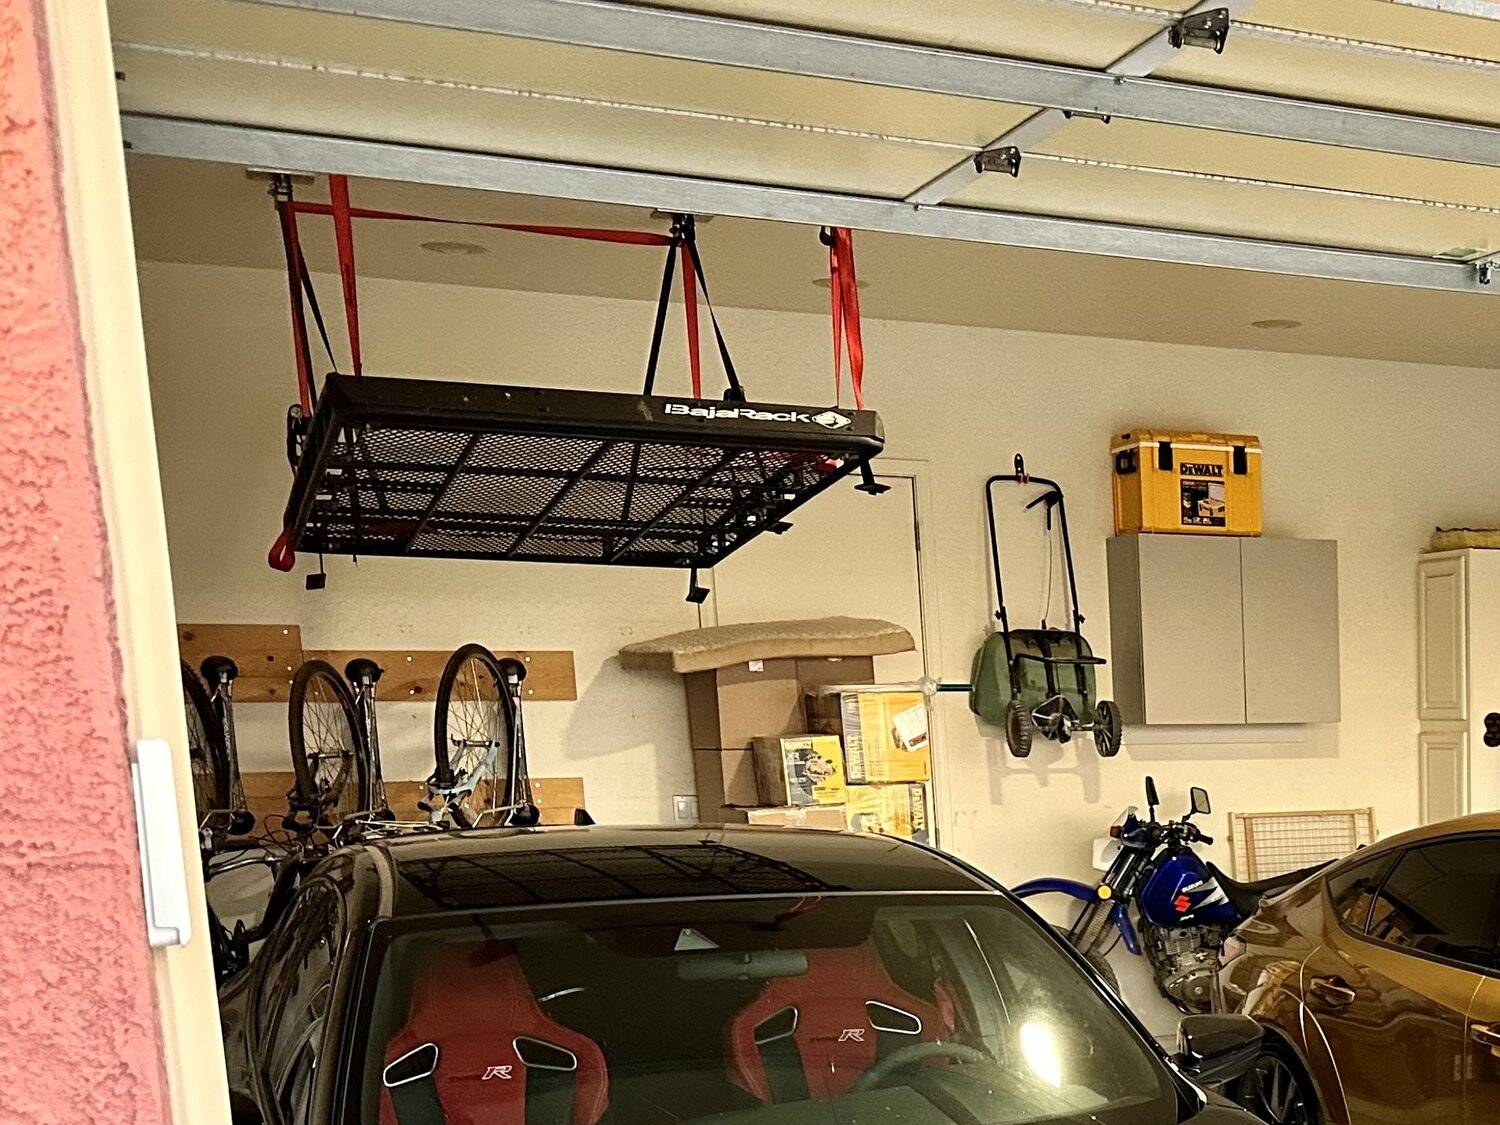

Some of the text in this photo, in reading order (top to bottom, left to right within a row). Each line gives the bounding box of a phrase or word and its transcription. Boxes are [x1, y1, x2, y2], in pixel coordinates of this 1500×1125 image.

[664, 403, 811, 424] BajaRack
[838, 1028, 865, 1042] R
[481, 1065, 513, 1080] R
